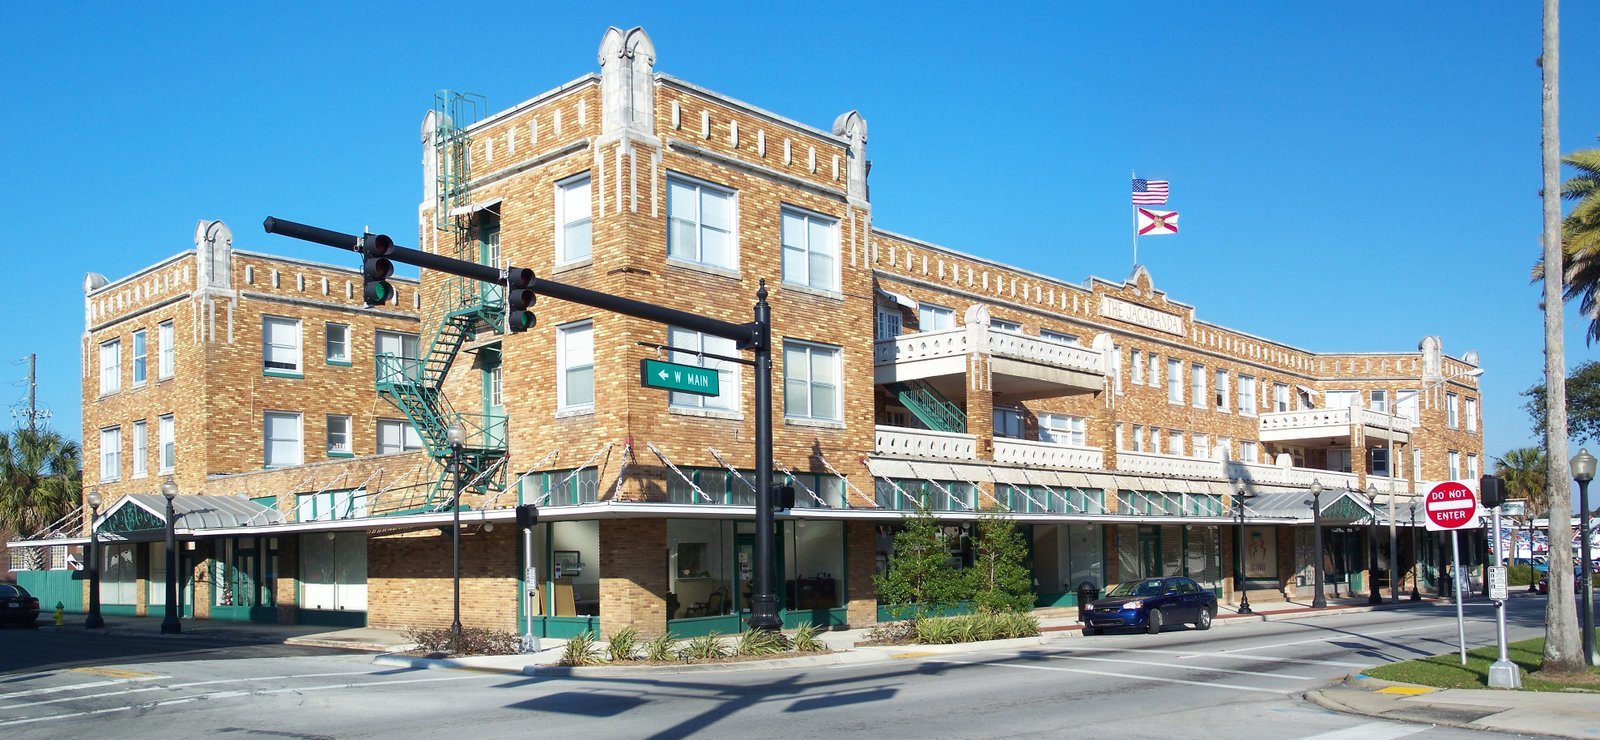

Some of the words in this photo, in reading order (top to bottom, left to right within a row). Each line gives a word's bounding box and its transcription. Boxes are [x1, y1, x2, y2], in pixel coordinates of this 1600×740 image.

[1107, 300, 1123, 318] THE
[1127, 305, 1178, 332] JACARANDA
[674, 370, 681, 383] W
[687, 373, 709, 387] MAIN
[1431, 491, 1445, 500] DO
[1449, 489, 1466, 499] NOT
[1436, 510, 1466, 520] ENTER
